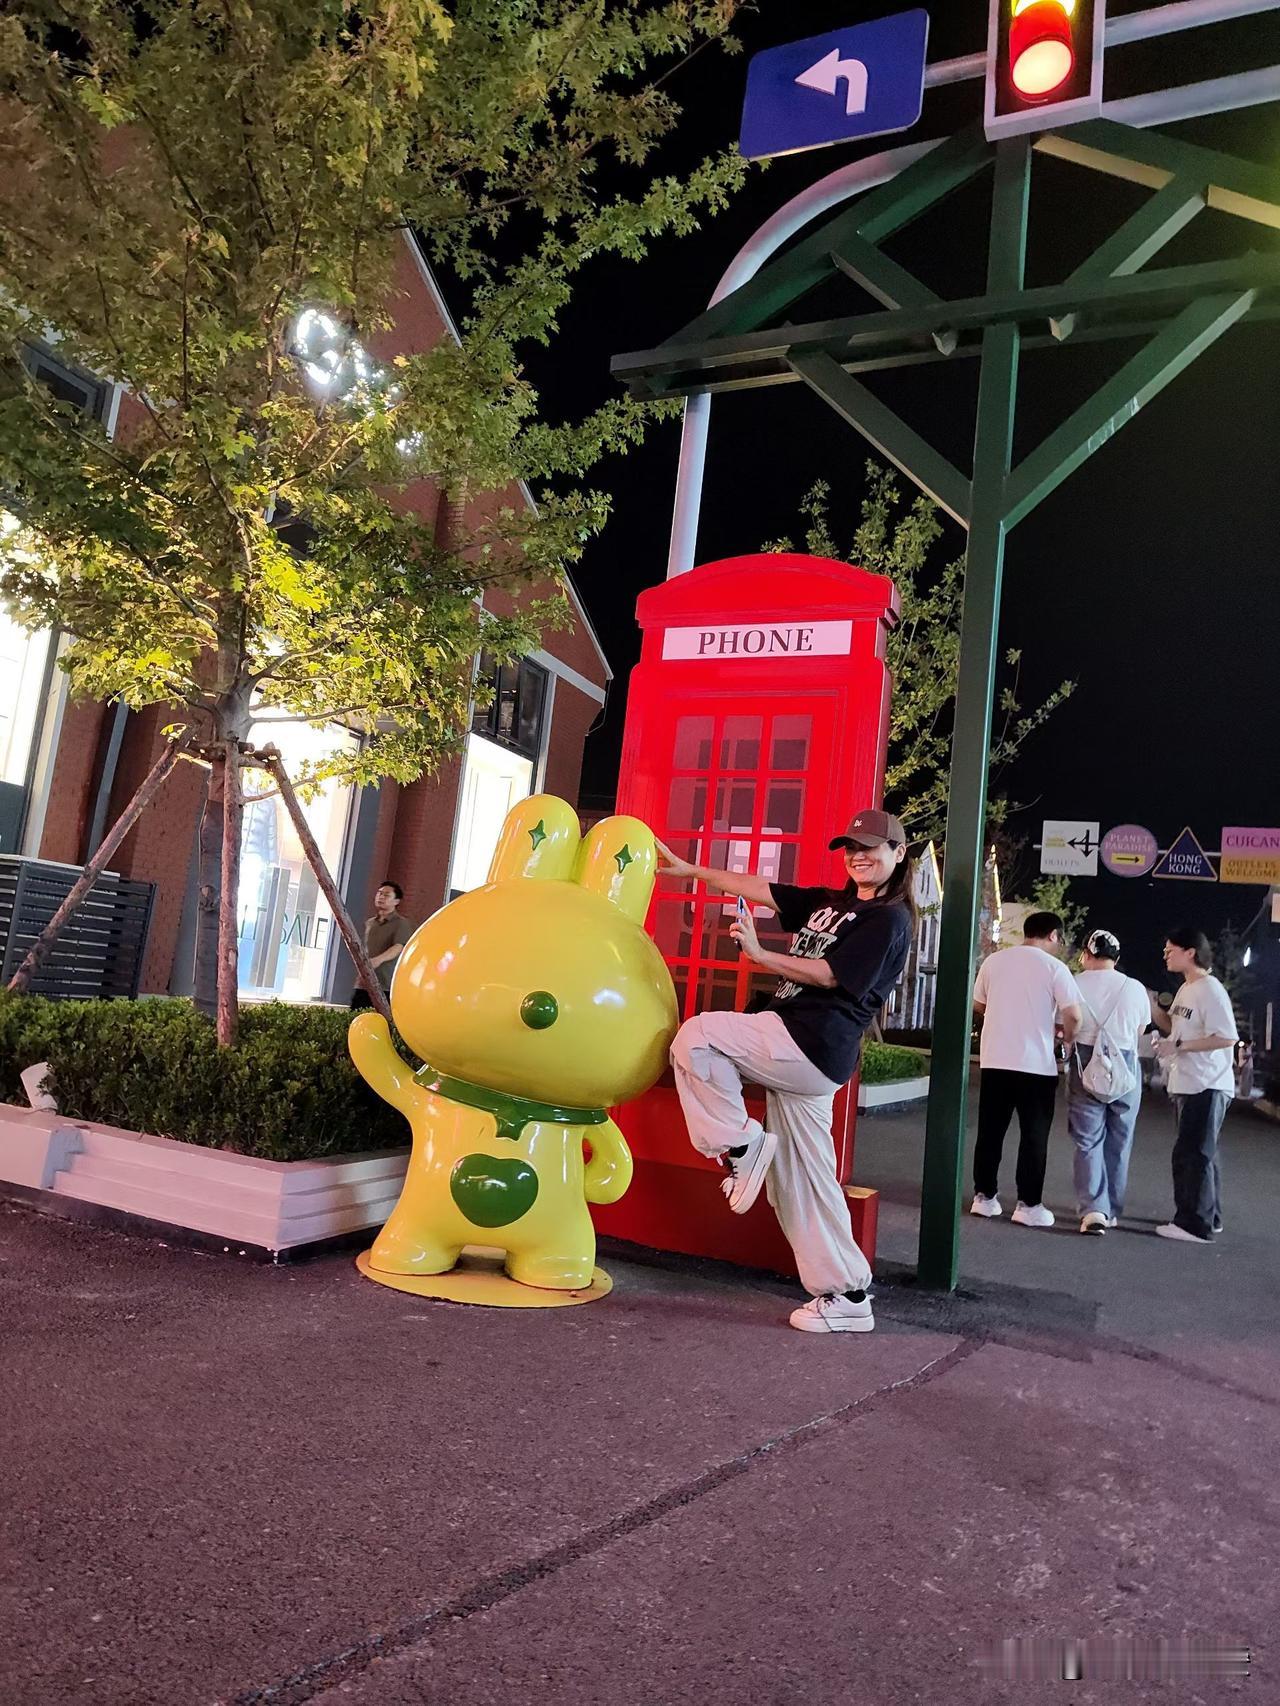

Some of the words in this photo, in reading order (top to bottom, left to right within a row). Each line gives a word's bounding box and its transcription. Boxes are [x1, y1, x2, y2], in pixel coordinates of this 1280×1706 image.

[697, 628, 814, 655] PHONE
[1110, 834, 1148, 844] PLANET
[1169, 854, 1202, 865] HONG
[1168, 864, 1200, 874] KONG
